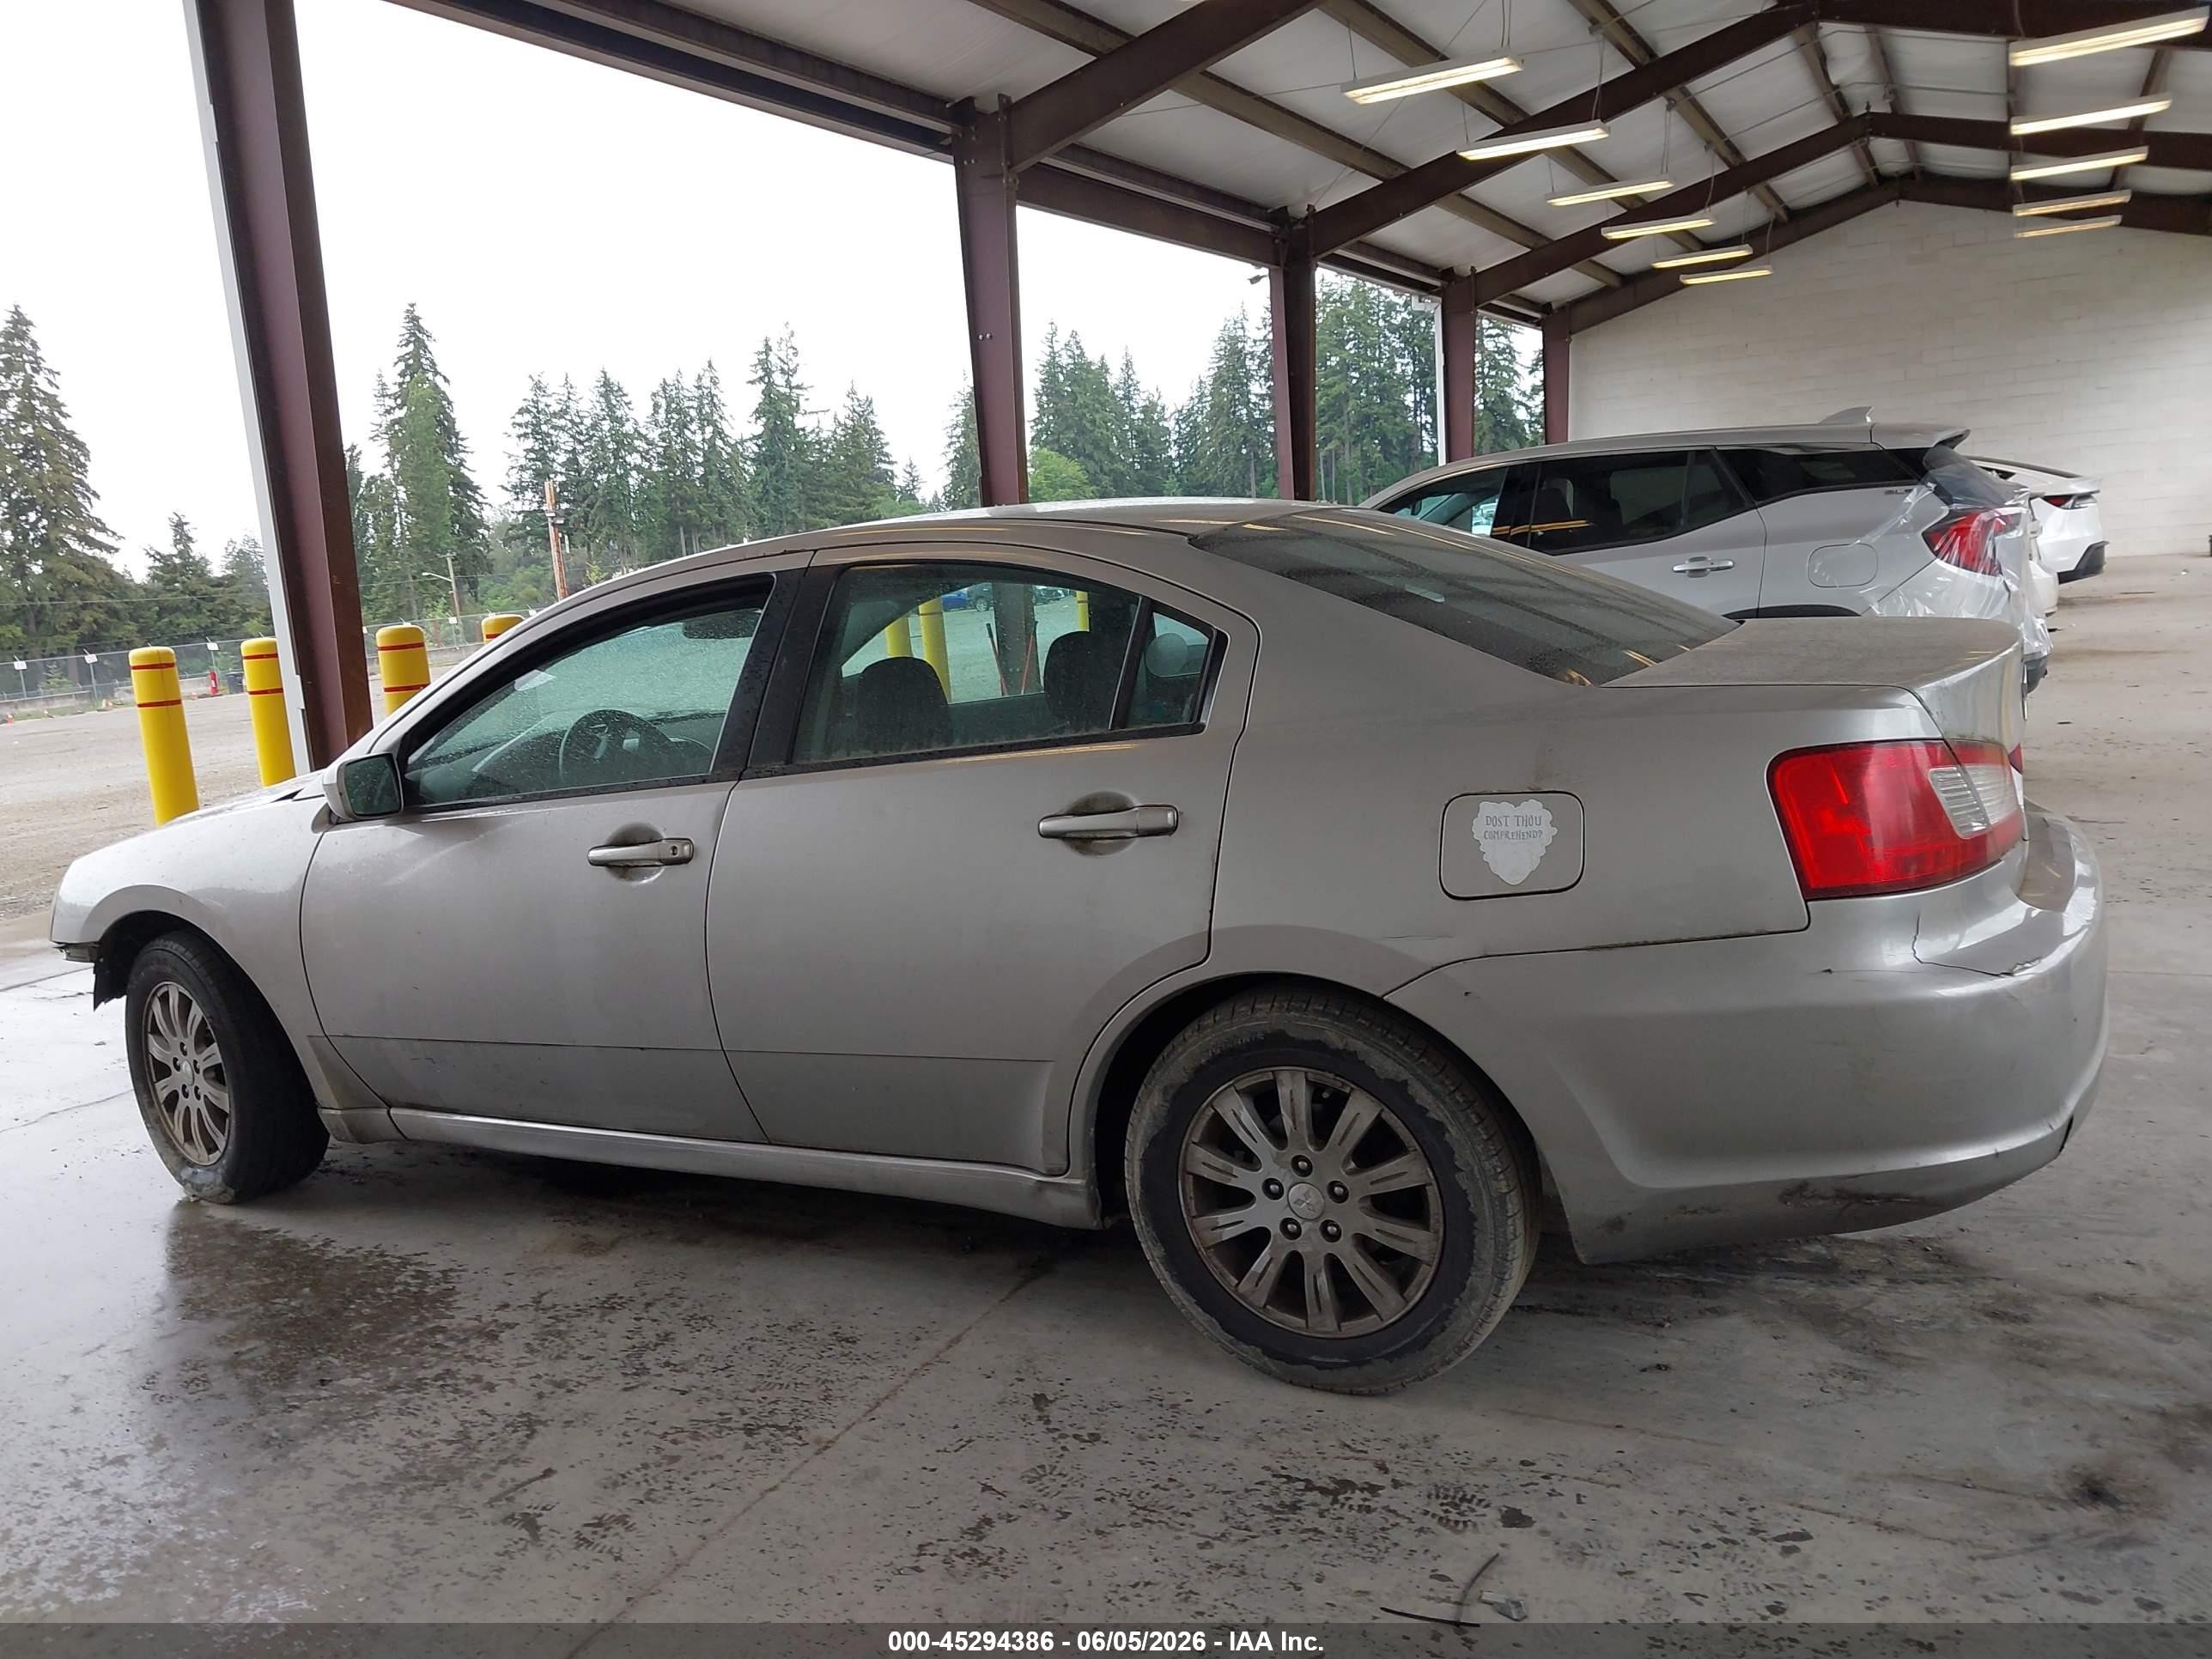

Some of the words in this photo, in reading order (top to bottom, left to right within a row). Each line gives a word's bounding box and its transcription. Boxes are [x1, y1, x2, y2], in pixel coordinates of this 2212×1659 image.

[1486, 816, 1510, 827] DOST
[1513, 815, 1542, 827] THOU
[1484, 830, 1543, 840] COMPREHEND?
